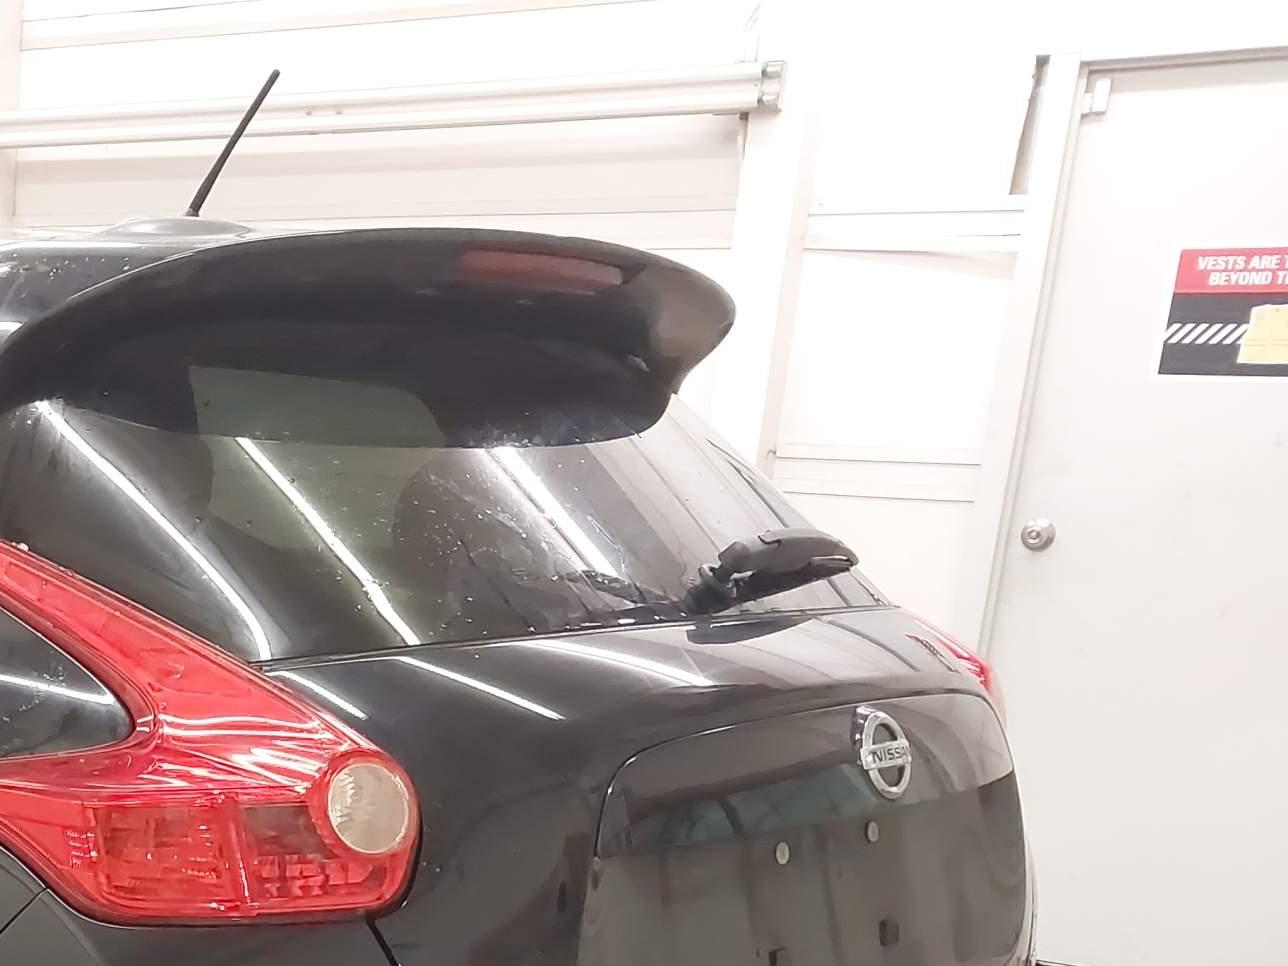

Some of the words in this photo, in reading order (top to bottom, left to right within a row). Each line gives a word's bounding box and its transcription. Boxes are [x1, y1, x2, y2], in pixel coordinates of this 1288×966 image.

[1198, 256, 1245, 270] VESTS
[1249, 255, 1281, 269] ARE
[1209, 271, 1273, 285] BEYOND
